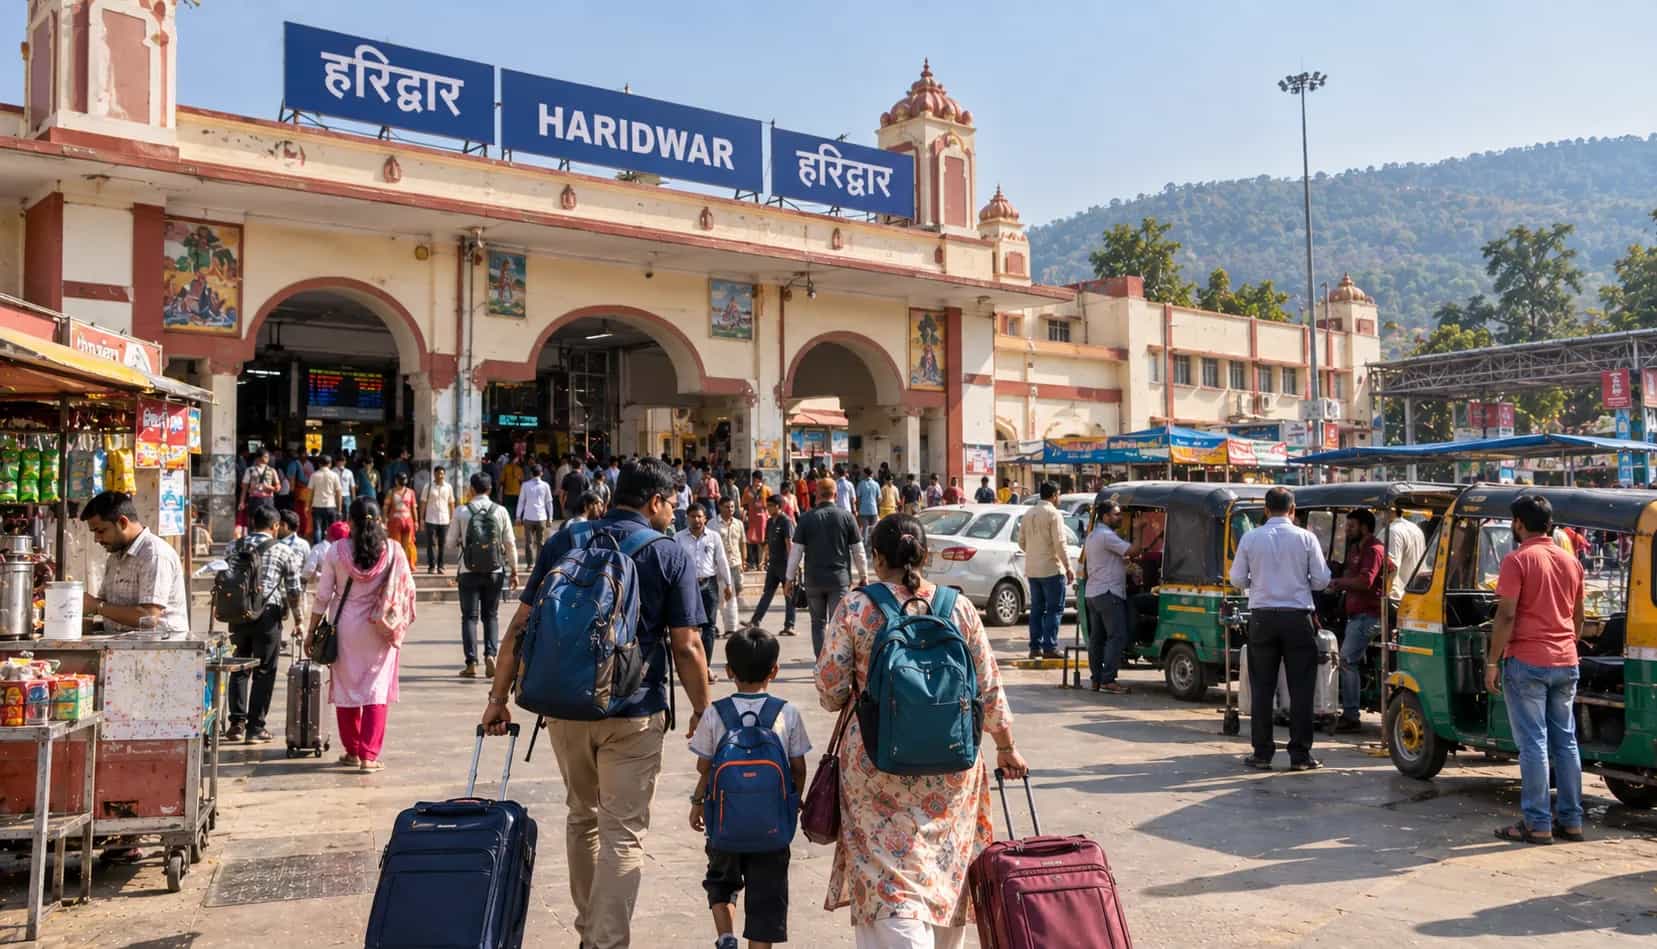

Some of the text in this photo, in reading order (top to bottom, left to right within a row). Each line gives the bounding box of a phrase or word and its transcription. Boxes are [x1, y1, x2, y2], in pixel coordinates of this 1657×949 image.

[321, 45, 464, 116] हरिद्वार
[538, 103, 735, 170] HARIDWAR
[796, 144, 893, 198] हरिद्वार
